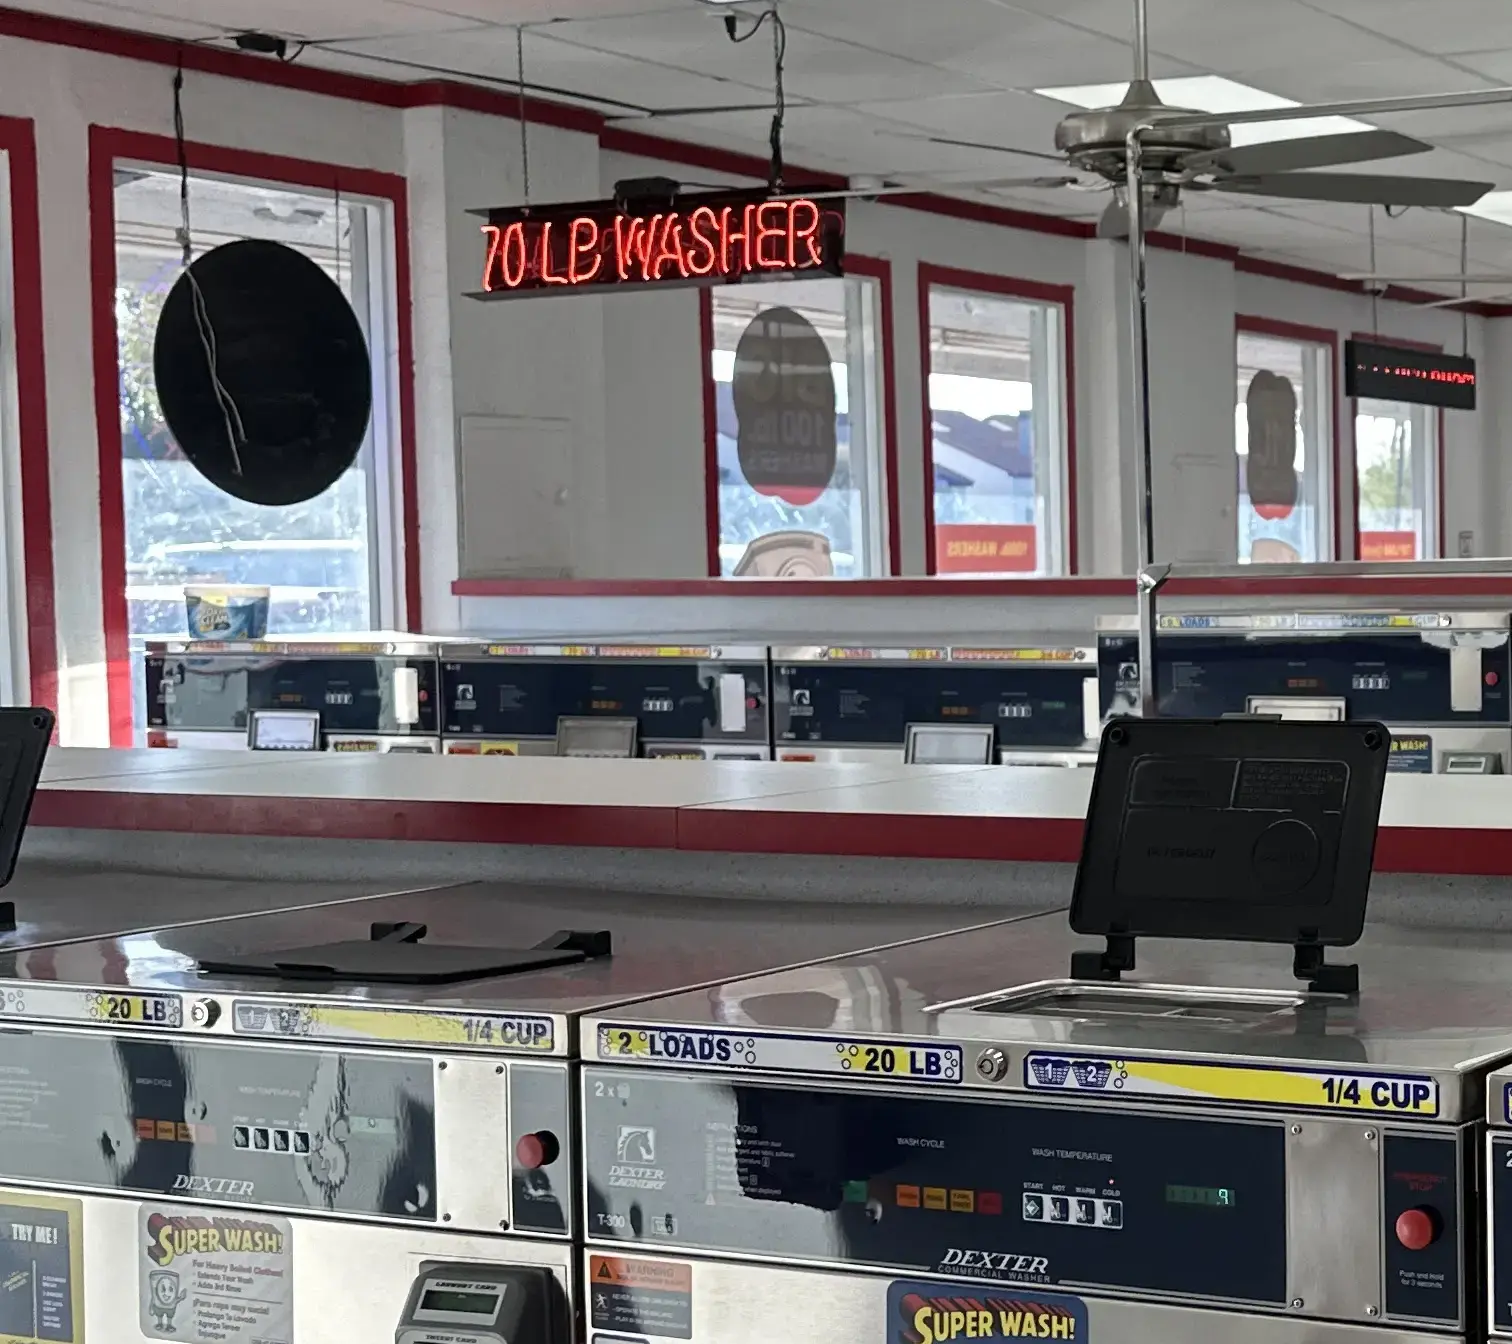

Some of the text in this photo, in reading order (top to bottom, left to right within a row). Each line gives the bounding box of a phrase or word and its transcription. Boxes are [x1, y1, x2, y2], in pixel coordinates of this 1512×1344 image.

[480, 199, 822, 292] 70 LB WASHER
[107, 996, 167, 1022] 20 LB
[462, 1018, 548, 1046] 1/4 CUP
[617, 1030, 942, 1076] 2 LOADS 20 LB
[595, 1081, 615, 1098] 2 x
[1322, 1077, 1431, 1111] 1/4 CUP
[1031, 1147, 1113, 1163] WASH TEMPERATURE
[609, 1165, 665, 1180] DEXTER
[172, 1174, 255, 1197] DEXTER
[1022, 1182, 1044, 1191] START
[1051, 1184, 1066, 1192] HOT
[1102, 1188, 1121, 1197] COLD
[597, 1213, 626, 1229] T-300
[11, 1223, 58, 1245] TRY ME!
[158, 1224, 285, 1267] SUPER WASH!
[942, 1247, 1049, 1275] DEXTER
[937, 1264, 1051, 1285] COMMERCIAL WASHER
[999, 1310, 1077, 1342] WASH!
